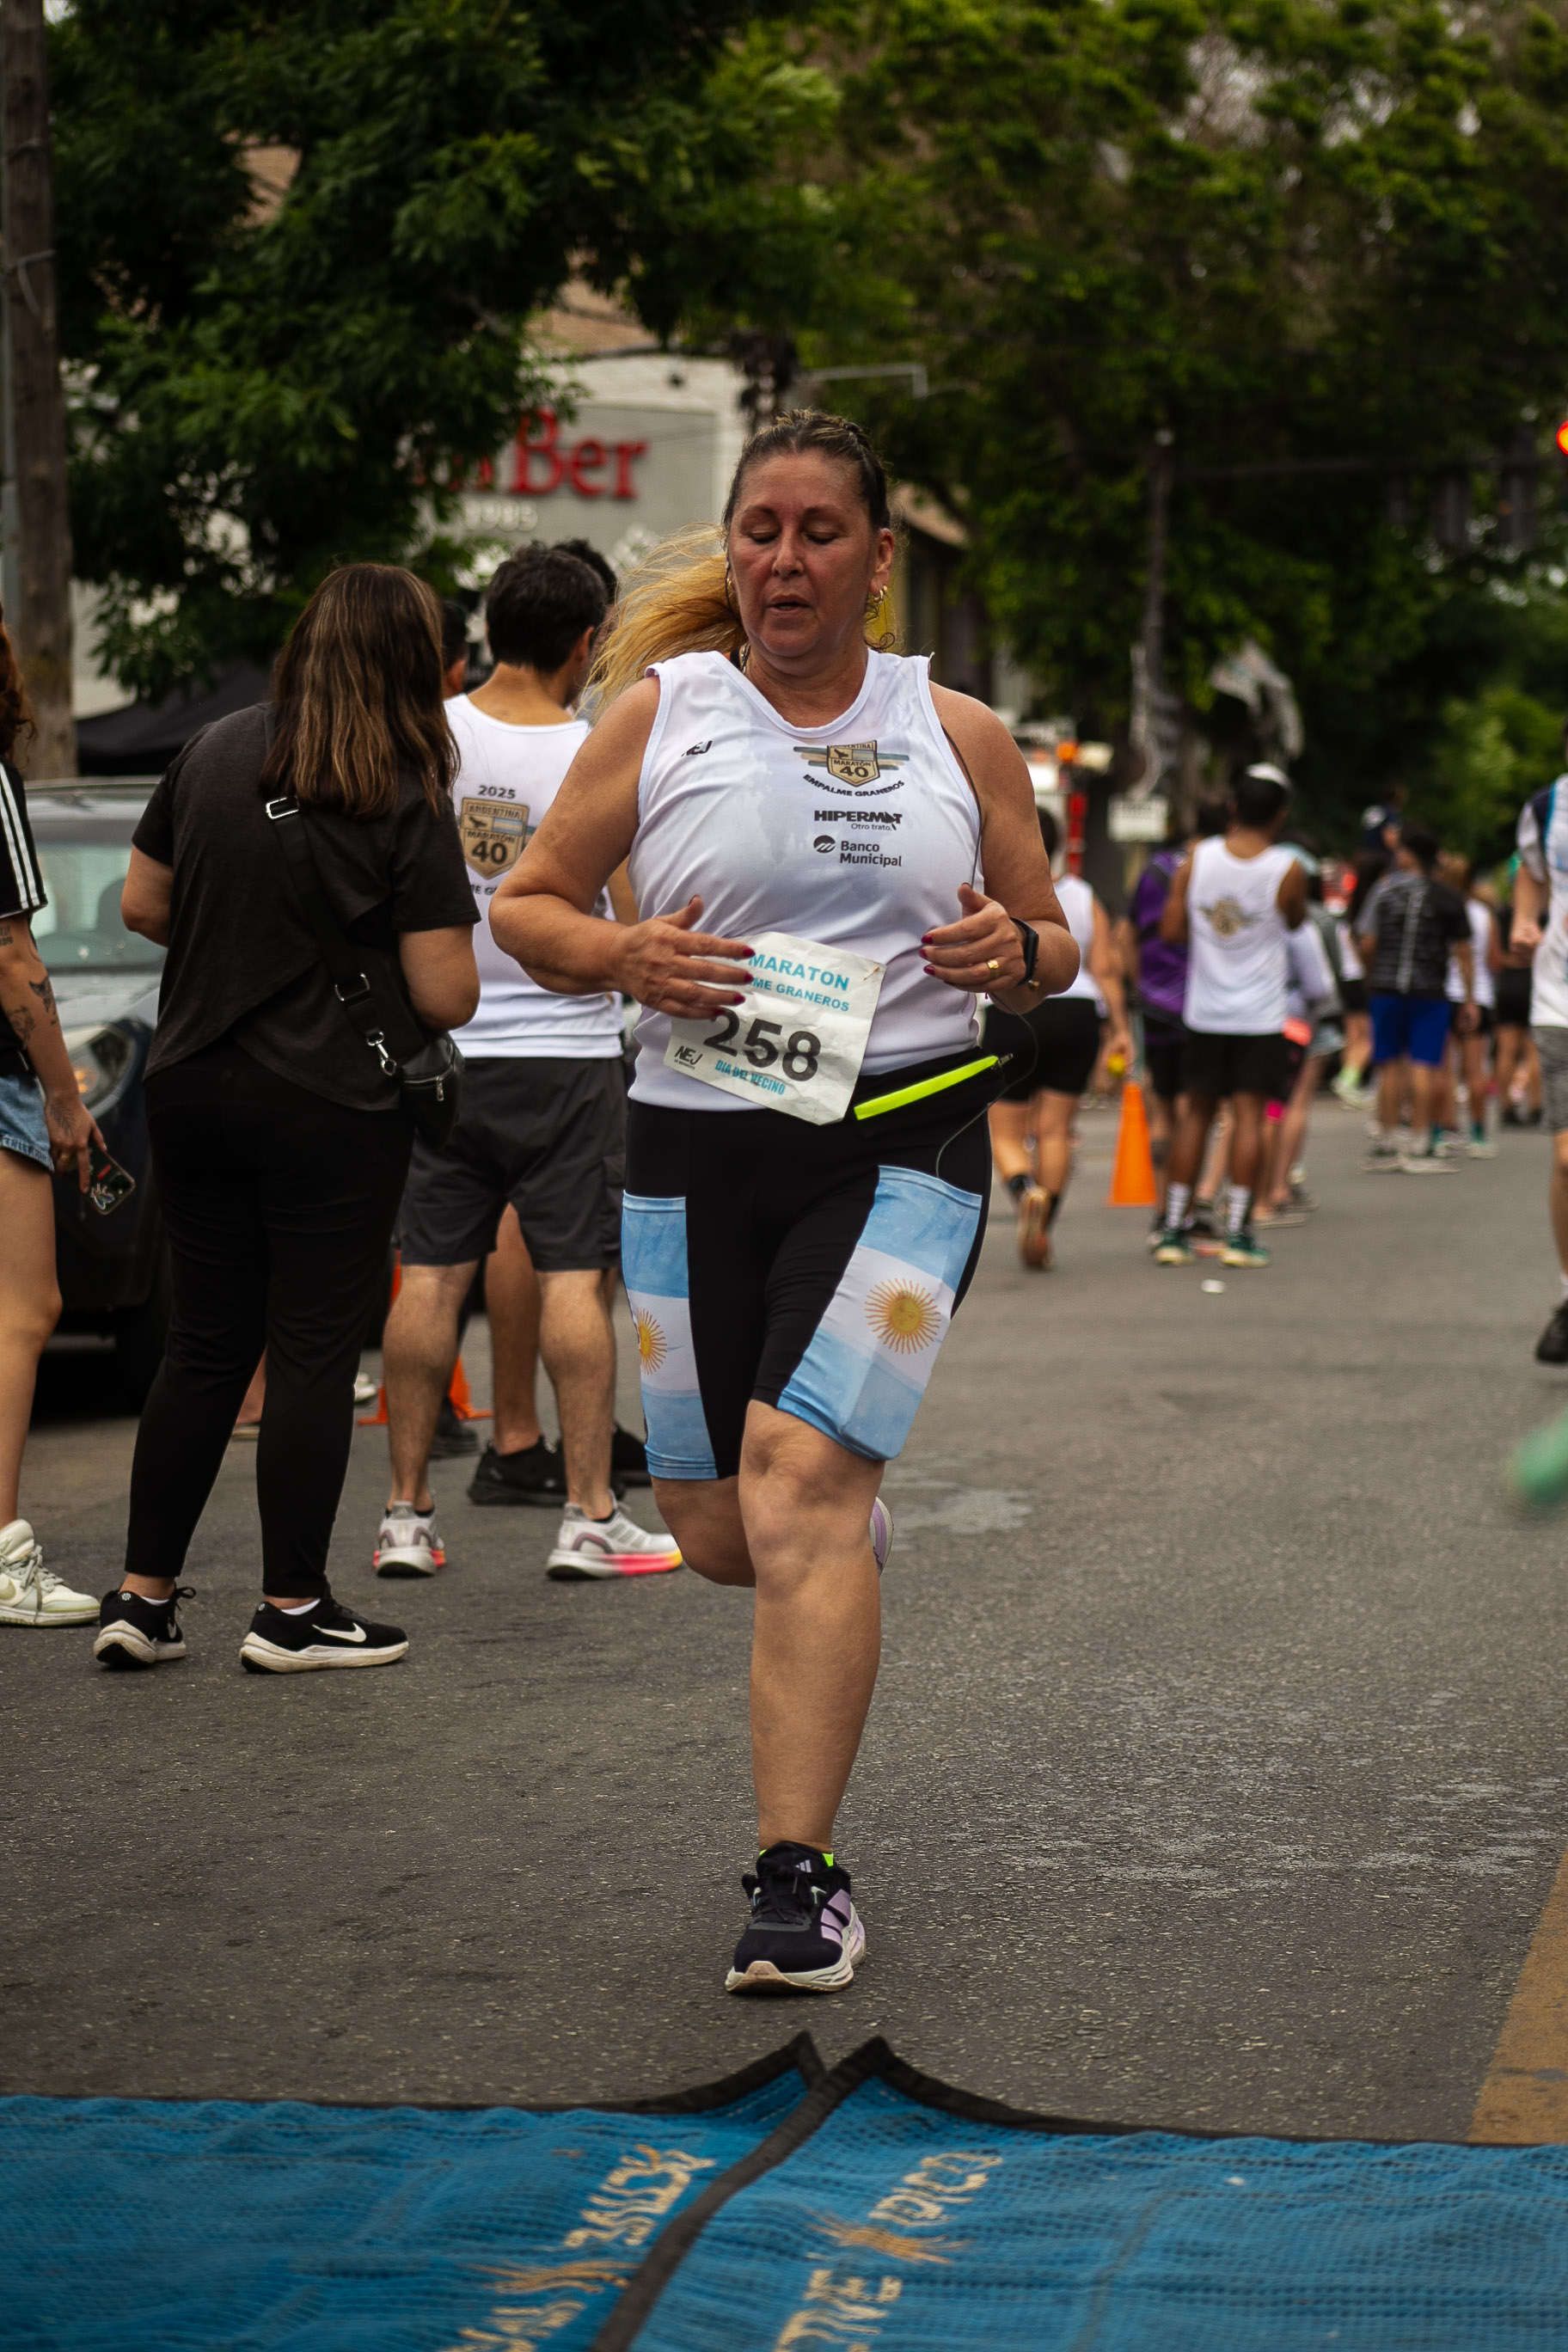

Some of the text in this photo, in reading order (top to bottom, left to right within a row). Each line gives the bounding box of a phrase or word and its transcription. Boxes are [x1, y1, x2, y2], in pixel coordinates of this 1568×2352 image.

[839, 766, 869, 778] 40
[478, 785, 516, 799] 2025
[803, 774, 905, 797] EMPALME GRANEROS
[471, 840, 508, 865] 40
[841, 840, 880, 853] Banco
[839, 853, 903, 868] Municipal
[748, 953, 850, 991] MARATON
[776, 983, 849, 1012] GRANEROS
[703, 1007, 821, 1082] 258
[715, 1059, 786, 1095] DIA DEL VECINO
